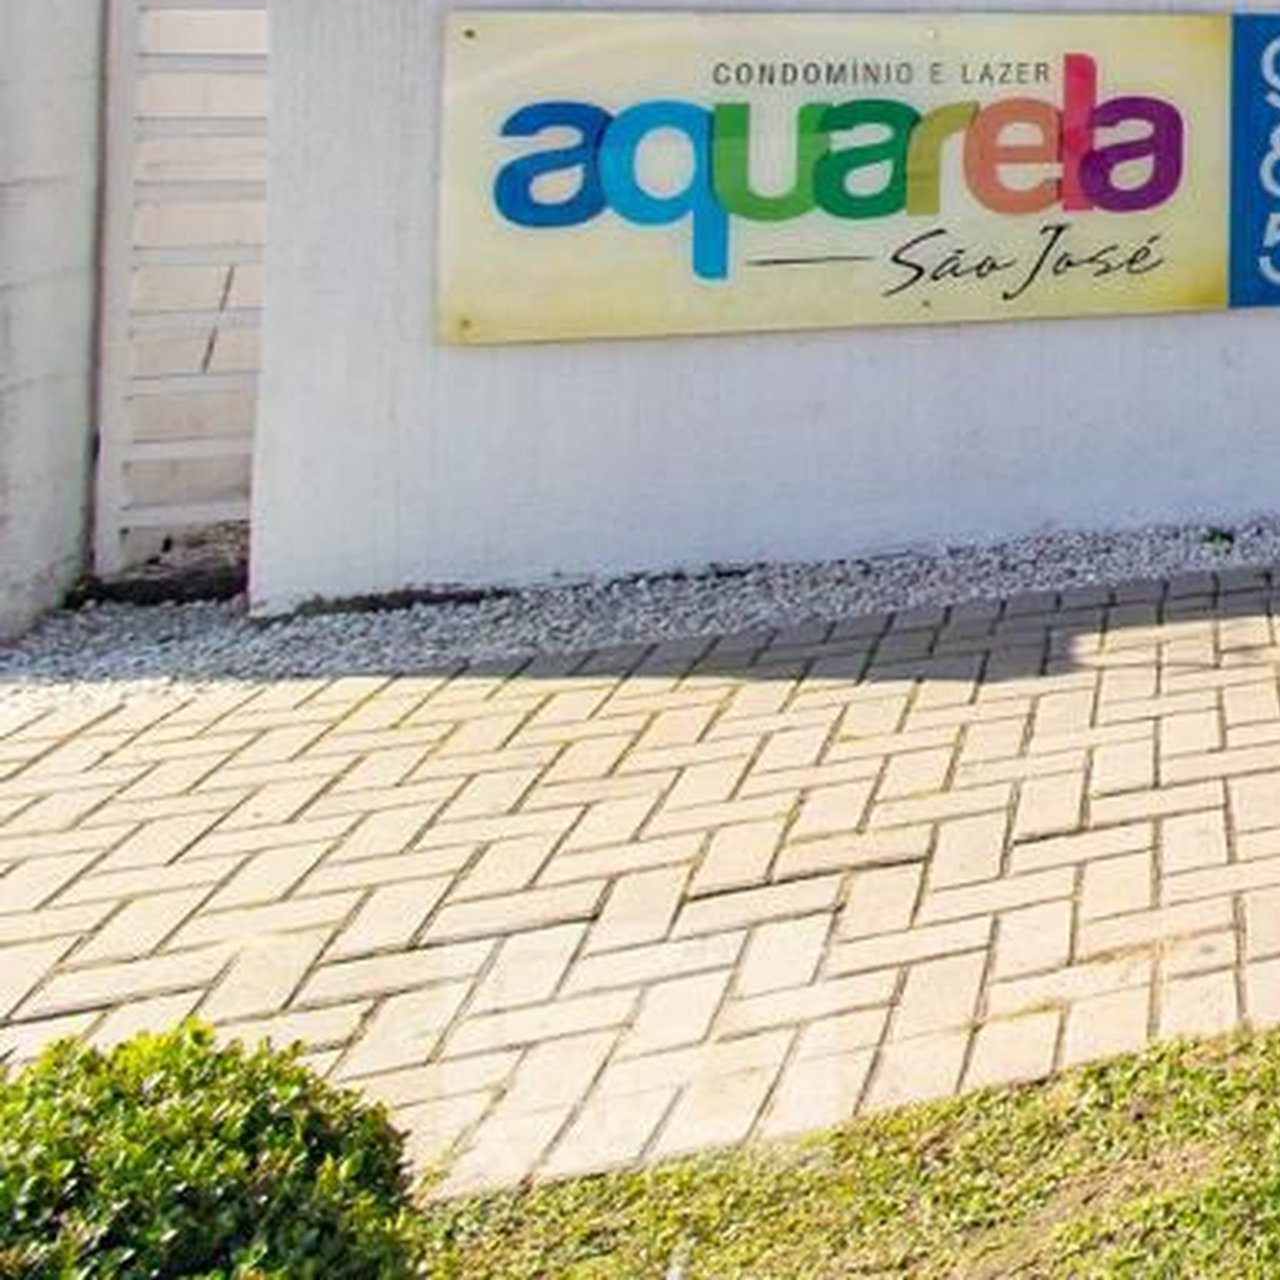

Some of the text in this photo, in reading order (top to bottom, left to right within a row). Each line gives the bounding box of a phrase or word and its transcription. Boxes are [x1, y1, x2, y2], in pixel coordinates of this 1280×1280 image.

[712, 59, 1050, 85] CONDOMÍNIO E LAZER
[493, 53, 1184, 279] aquarela
[881, 224, 1164, 301] São José
